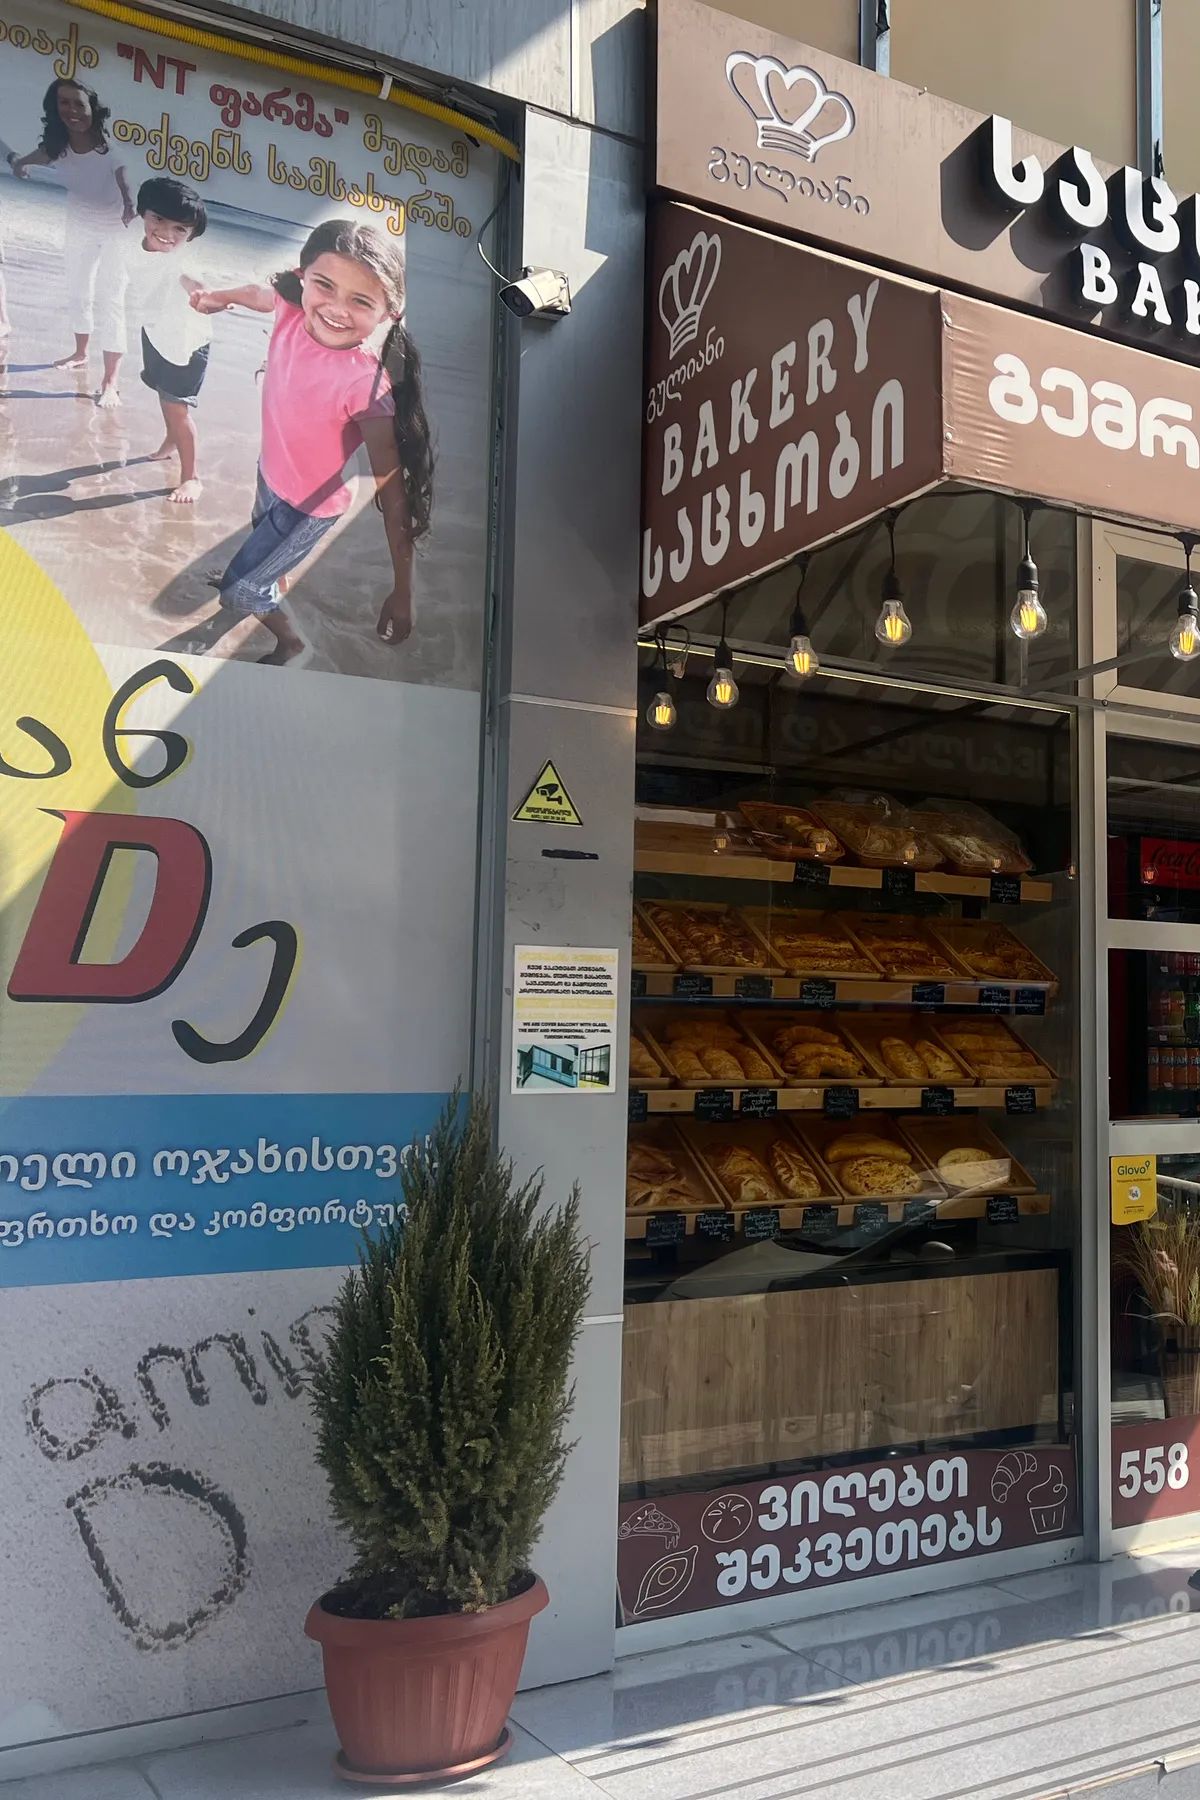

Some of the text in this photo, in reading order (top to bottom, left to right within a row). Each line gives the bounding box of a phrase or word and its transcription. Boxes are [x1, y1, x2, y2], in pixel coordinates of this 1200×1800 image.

[0, 20, 100, 81] იაქი
[117, 42, 197, 95] "NT
[362, 113, 469, 185] მუდამ
[112, 112, 473, 238] თქვენს სამსახურში
[708, 146, 870, 216] გულიანი
[646, 325, 726, 425] გულიანი
[660, 278, 880, 497] BAKERY
[642, 378, 905, 599] საცხობი
[1117, 1163, 1147, 1176] Glovo
[149, 1213, 196, 1239] და
[757, 1455, 970, 1533] ვიღებთ
[1118, 1442, 1190, 1499] 558
[714, 1506, 1003, 1598] შეკვეთებს
